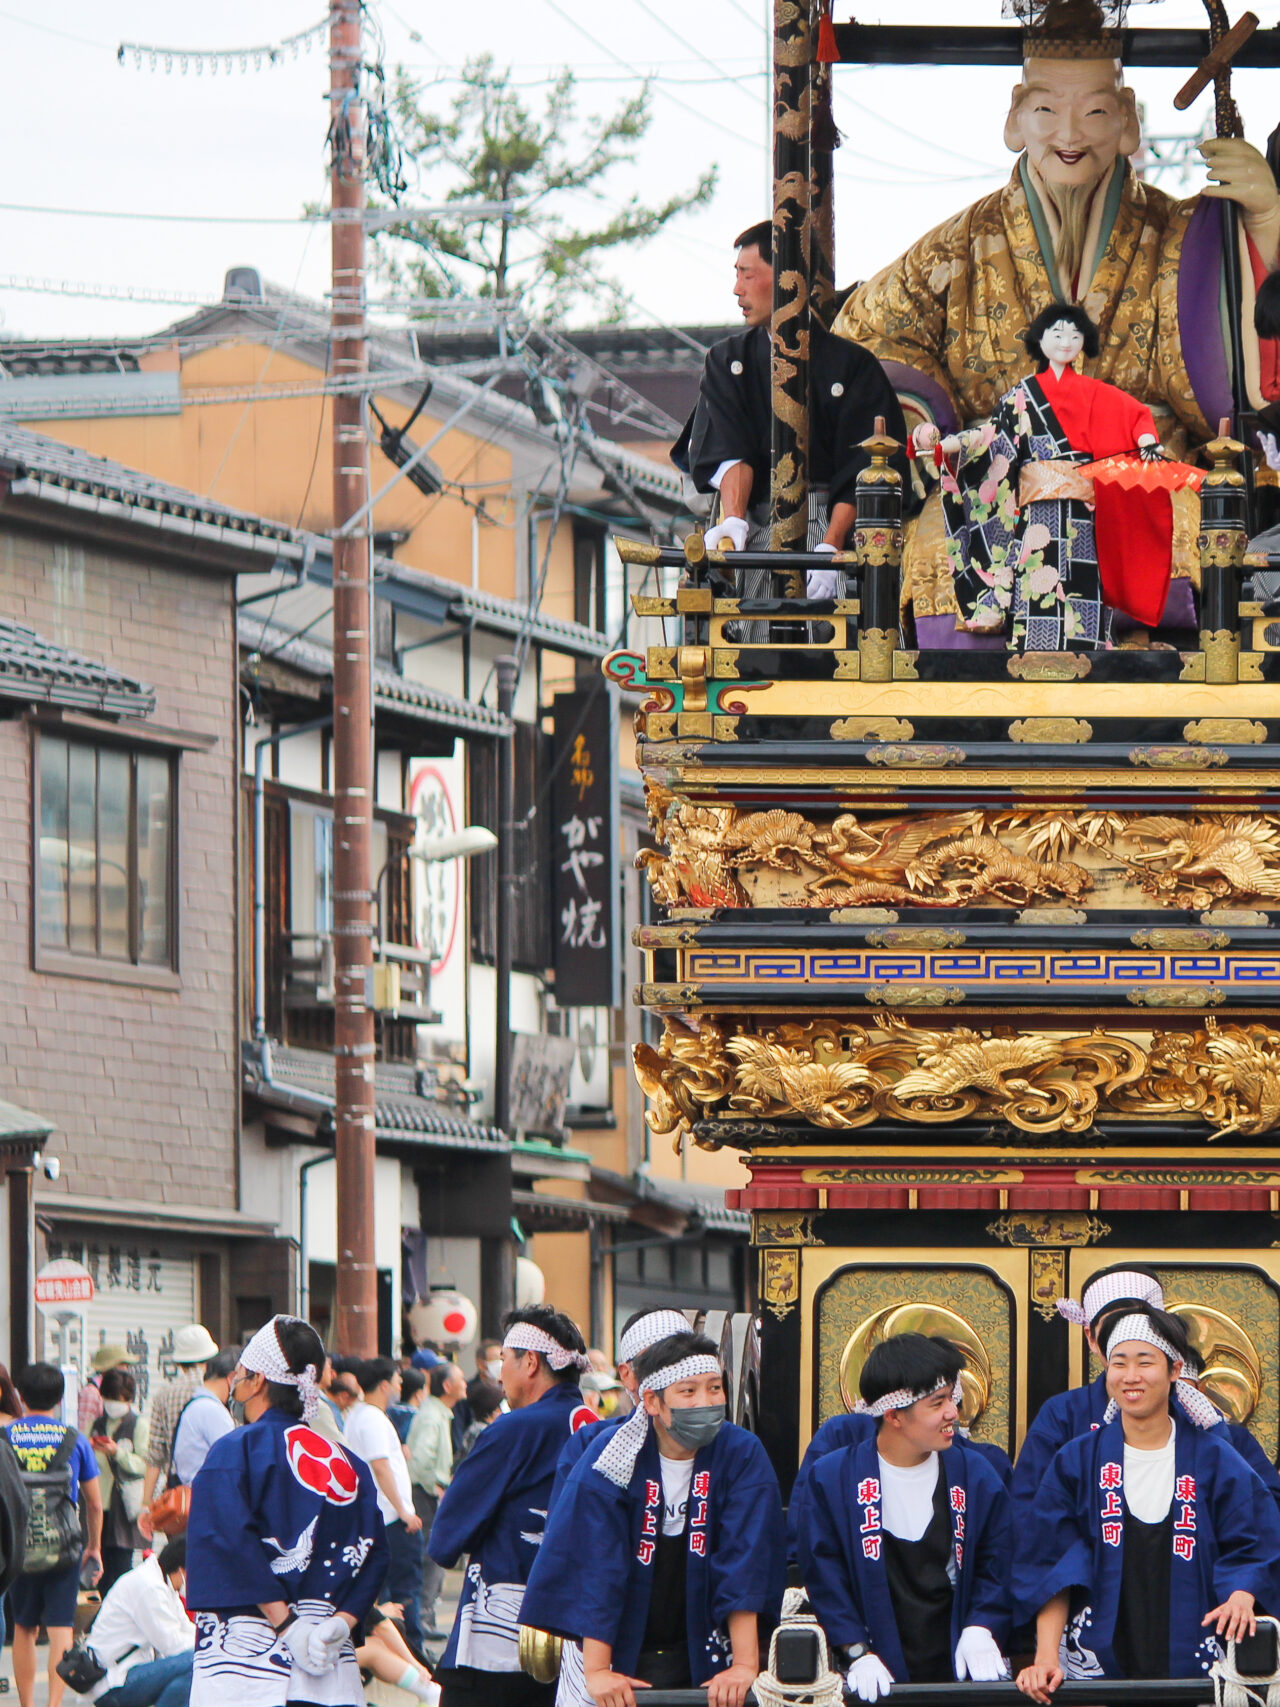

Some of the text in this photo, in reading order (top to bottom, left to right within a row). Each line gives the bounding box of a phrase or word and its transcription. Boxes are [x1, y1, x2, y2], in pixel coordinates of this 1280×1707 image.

[11, 1423, 67, 1434] ALL JAPAN
[857, 1478, 882, 1561] 東上町
[1099, 1461, 1123, 1548] 東上町
[1174, 1475, 1196, 1561] 東上町
